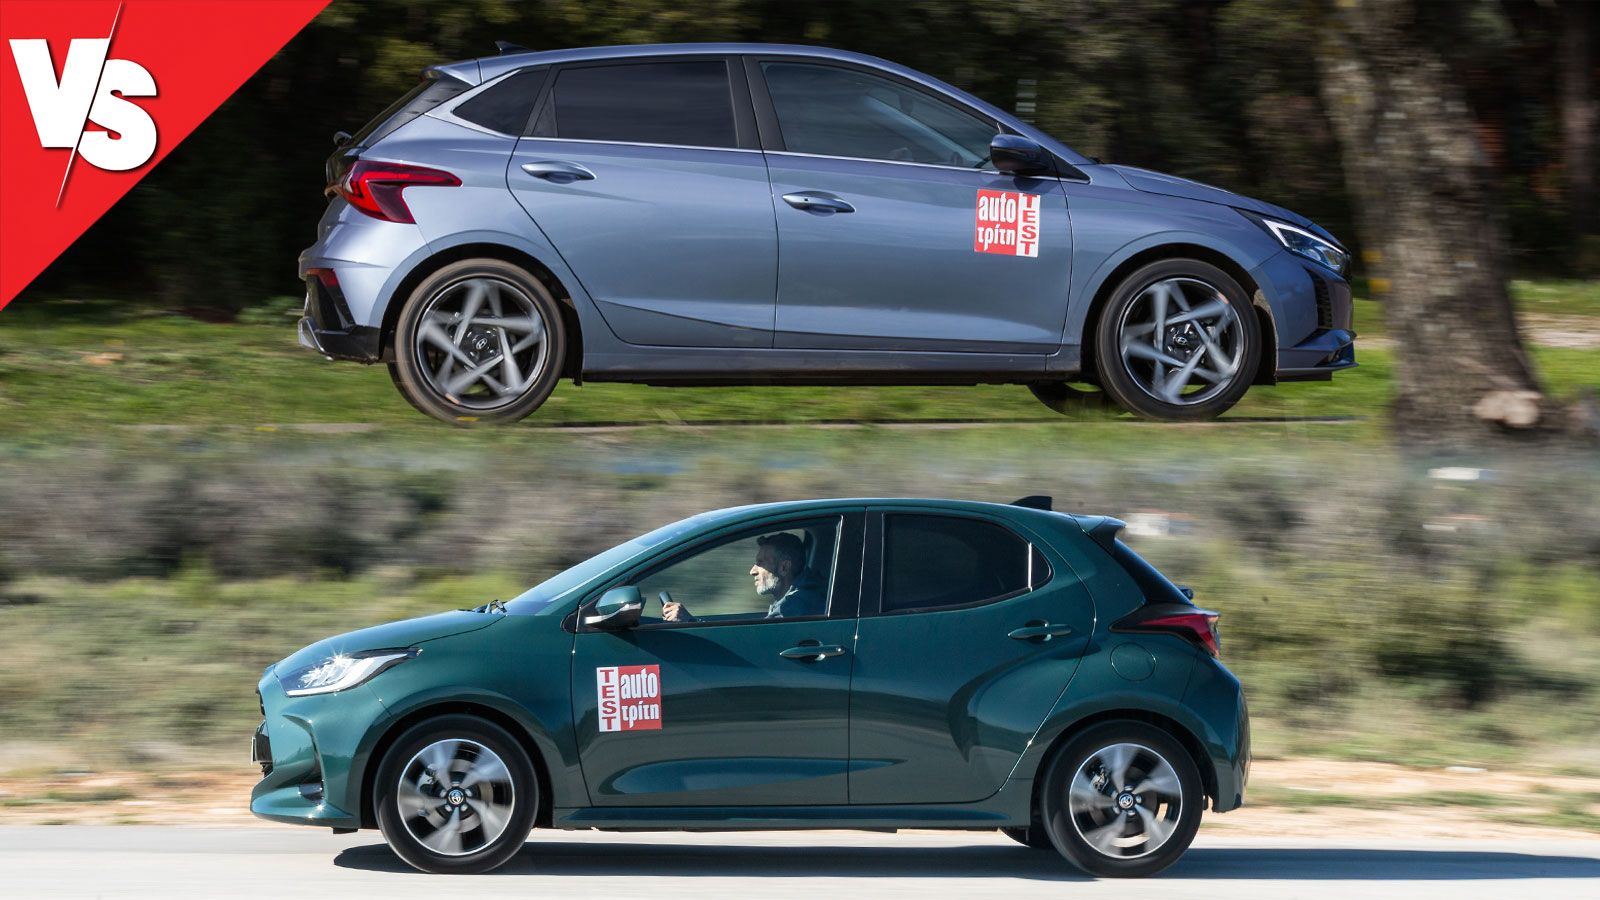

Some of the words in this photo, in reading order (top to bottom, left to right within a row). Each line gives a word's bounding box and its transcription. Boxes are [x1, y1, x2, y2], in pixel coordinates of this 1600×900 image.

[978, 192, 1017, 224] auto
[1020, 193, 1038, 255] TEST
[599, 669, 617, 730] TEST
[620, 667, 658, 700] auto
